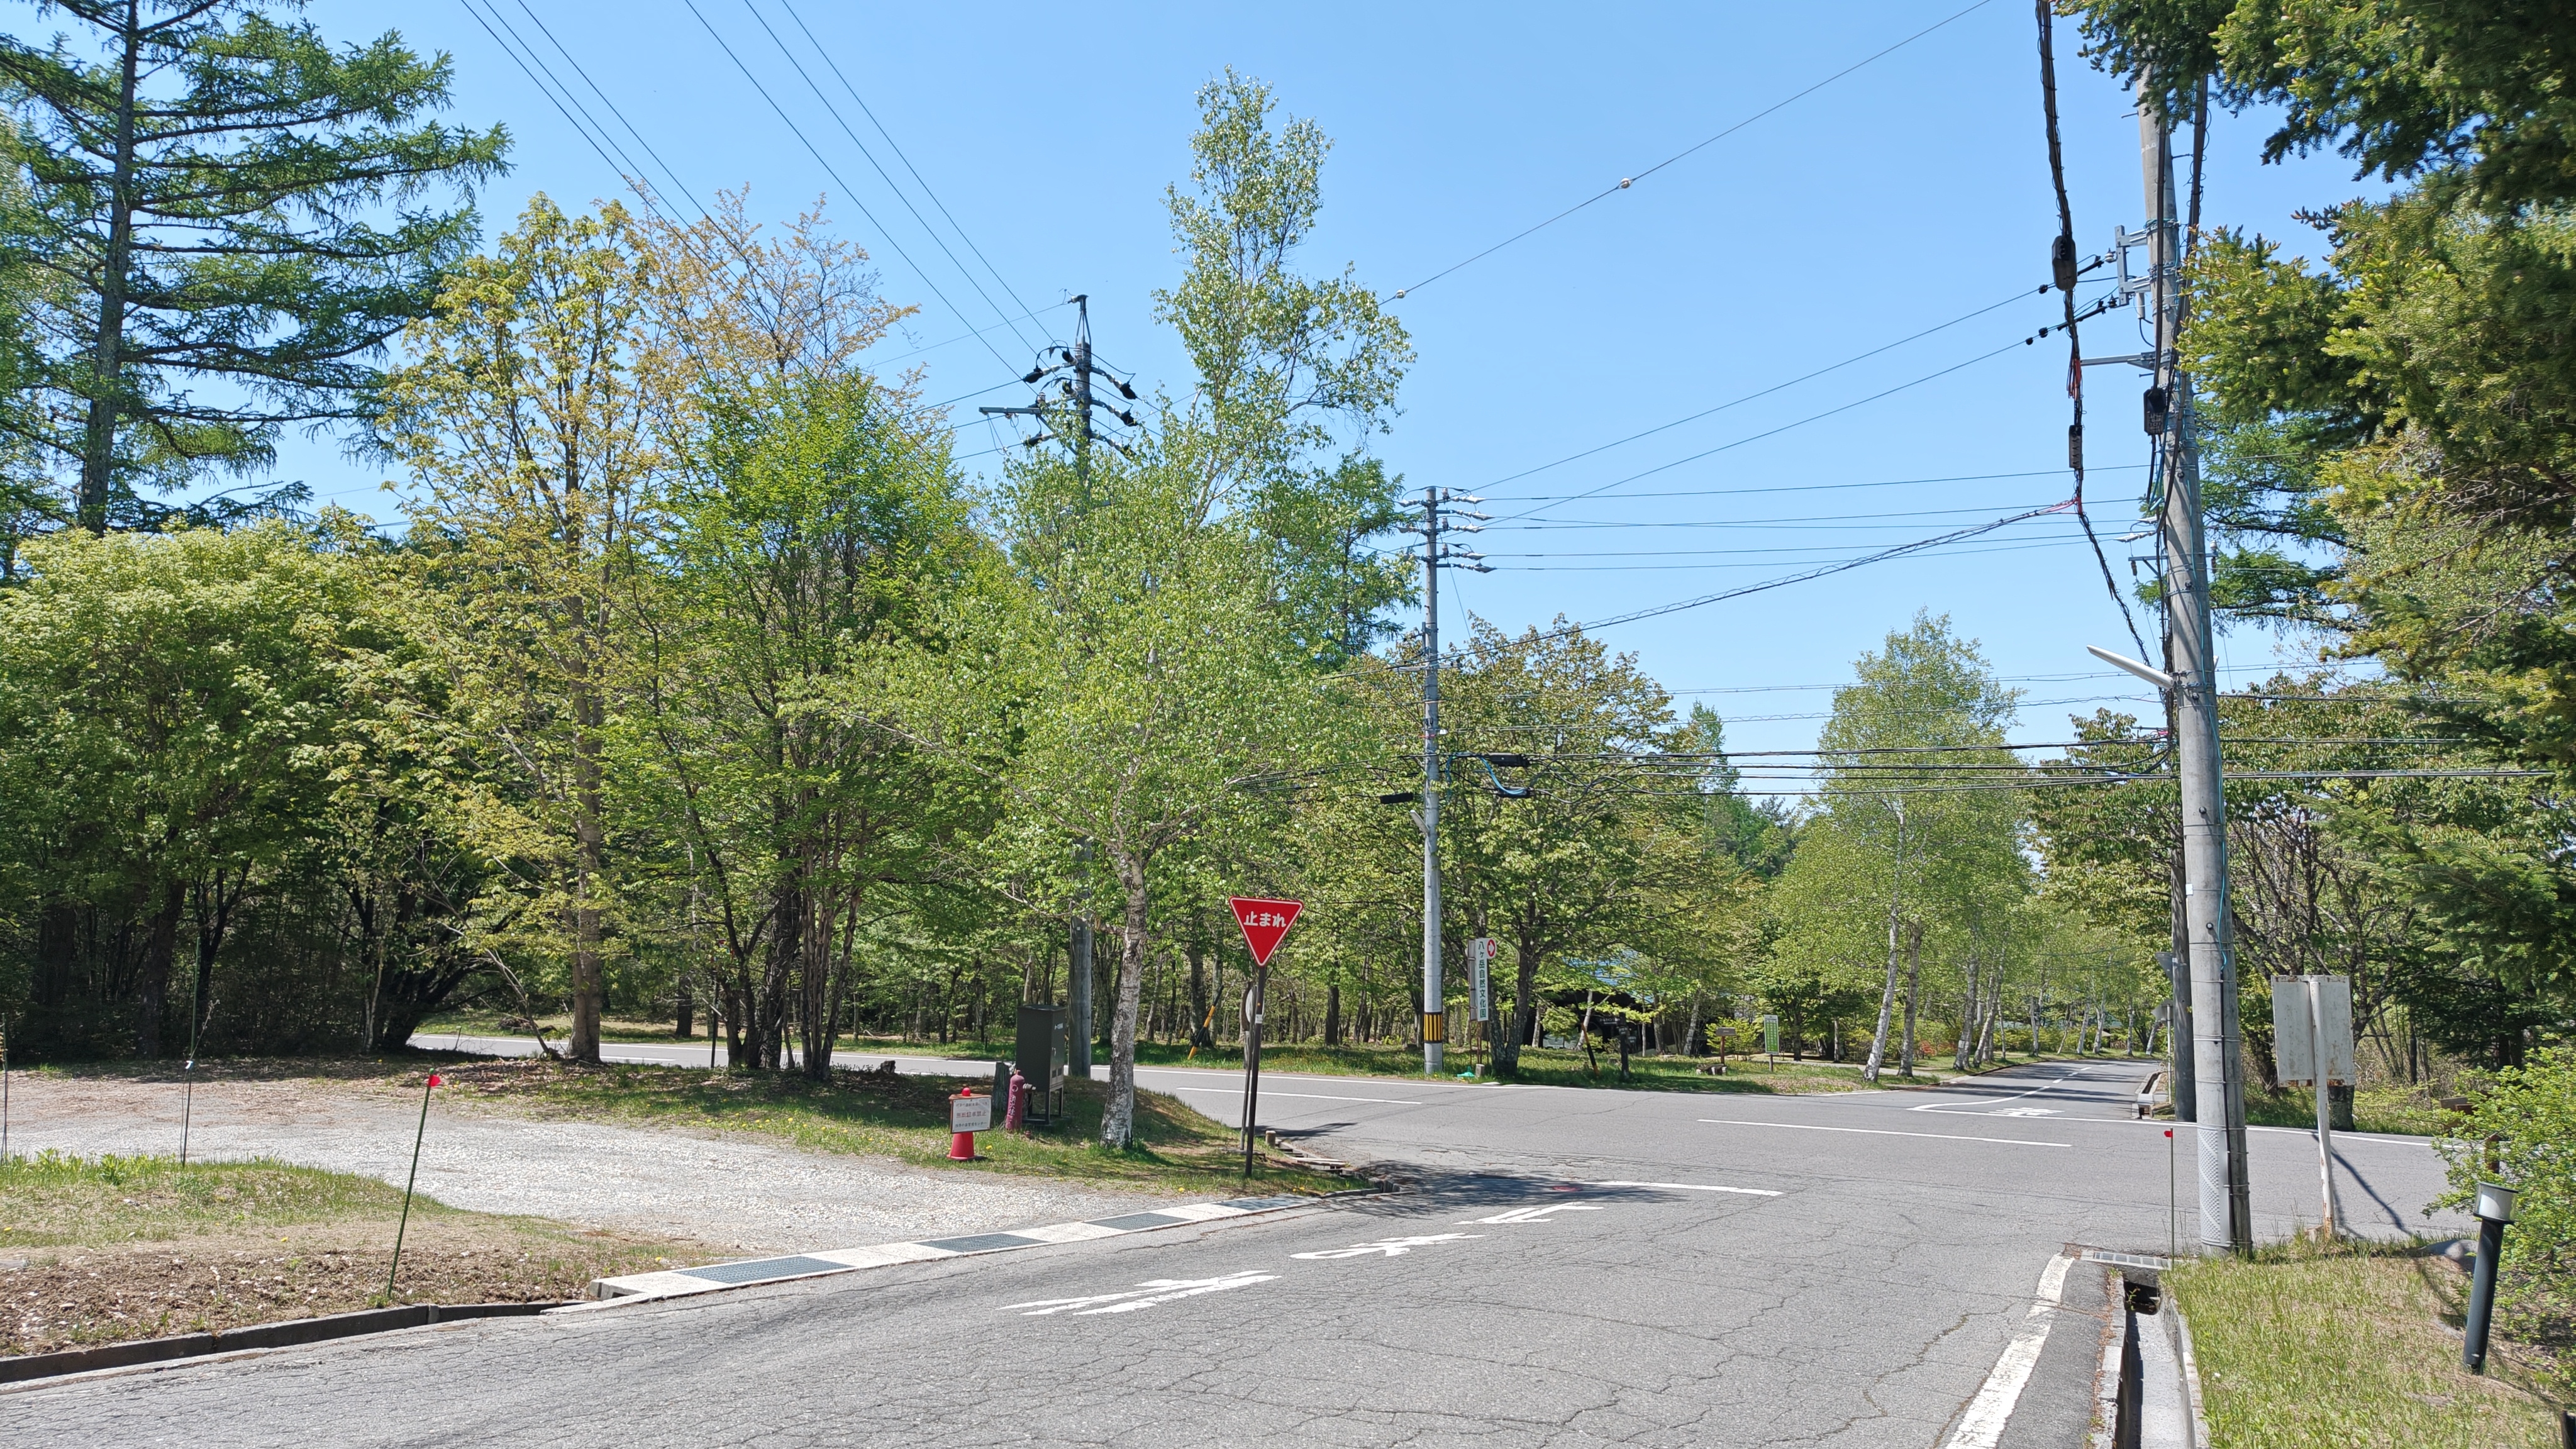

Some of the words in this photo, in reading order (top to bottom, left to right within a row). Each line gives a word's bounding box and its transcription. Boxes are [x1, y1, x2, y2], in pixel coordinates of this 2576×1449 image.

[1243, 911, 1287, 928] 止まれ
[996, 1201, 1604, 1316] 止まれ
